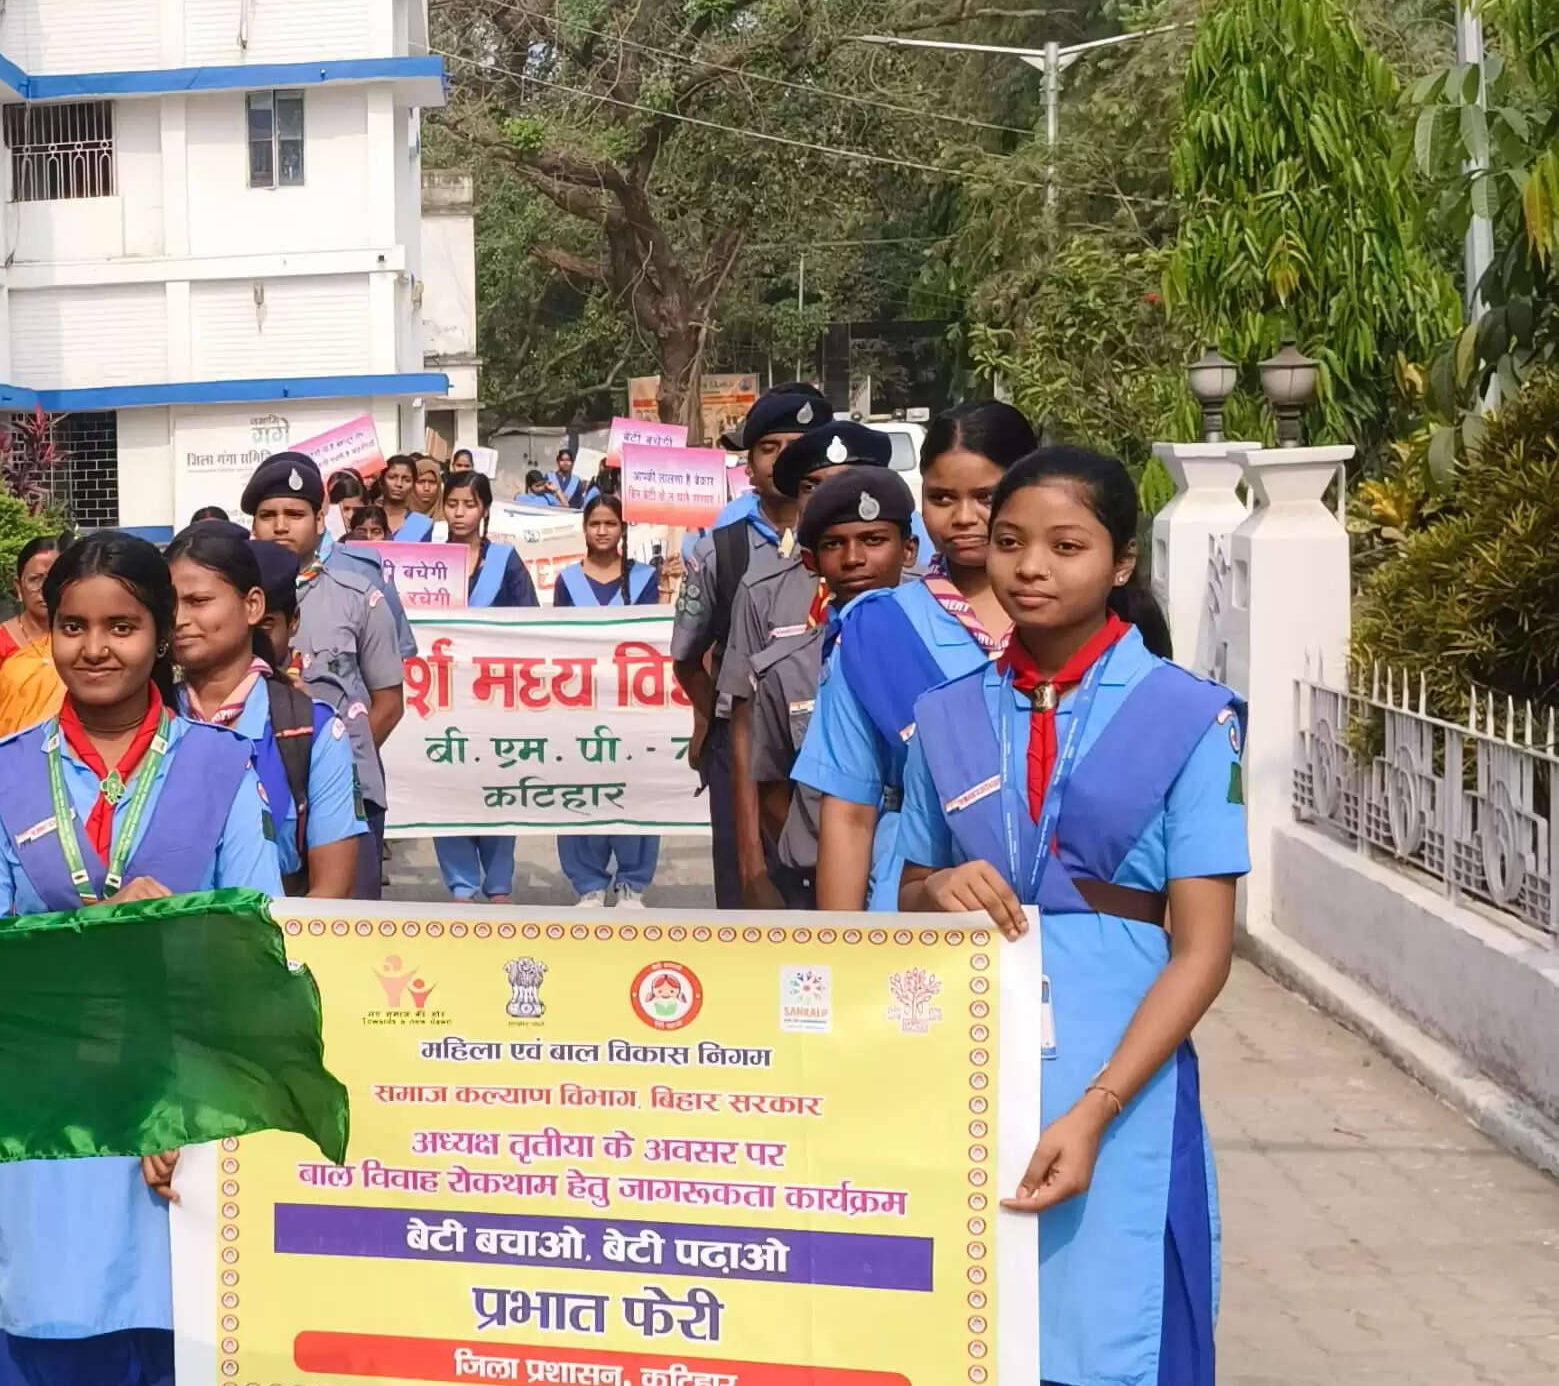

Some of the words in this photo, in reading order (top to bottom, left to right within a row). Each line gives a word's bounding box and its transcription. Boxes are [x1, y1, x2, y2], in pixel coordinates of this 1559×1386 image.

[402, 560, 449, 581] बचेगी
[407, 587, 451, 606] रचेगी
[483, 775, 627, 816] कटिहार
[421, 1037, 501, 1061] महिला
[510, 1038, 541, 1061] एवं
[550, 1043, 599, 1063] बाल
[608, 1039, 690, 1065] विकास
[698, 1041, 772, 1067] निगम
[373, 1084, 448, 1103] समाज
[455, 1085, 552, 1106] कल्याण
[650, 1086, 719, 1113] बिहार
[727, 1093, 824, 1116] सरकार
[509, 1127, 594, 1164] तृतीया
[603, 1130, 635, 1159] के
[644, 1139, 739, 1165] अवसर
[745, 1143, 786, 1167] पर
[298, 1163, 356, 1187] बाल
[361, 1159, 441, 1193] विवाह
[448, 1166, 558, 1196] रोकथाम
[567, 1169, 611, 1208] हेतु
[618, 1178, 777, 1208] जागरूकता
[784, 1181, 908, 1216] कार्यक्रम
[406, 1217, 467, 1253] बेटी
[602, 1228, 665, 1265] बेटी
[674, 1238, 791, 1274] पढ़ाओ
[471, 1286, 610, 1334] प्रभात
[622, 1286, 726, 1341] फेरी
[453, 1347, 519, 1380] जिला
